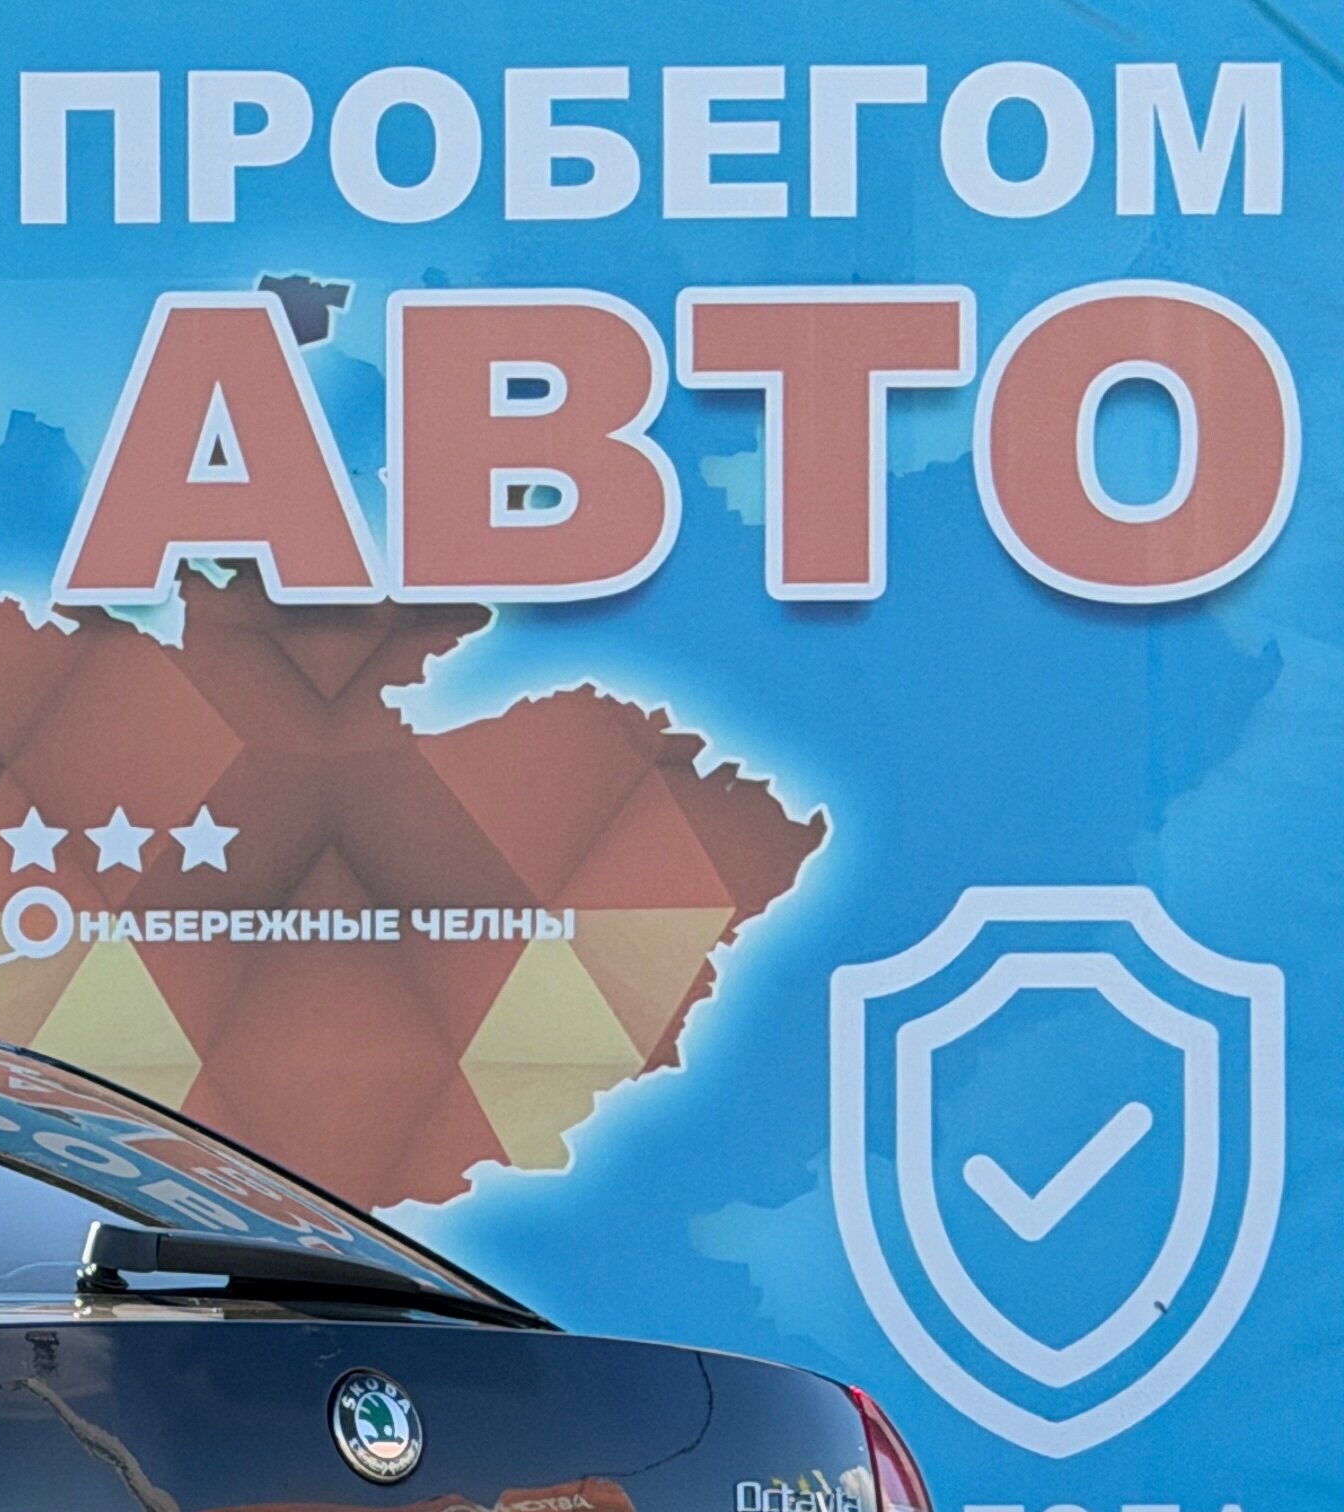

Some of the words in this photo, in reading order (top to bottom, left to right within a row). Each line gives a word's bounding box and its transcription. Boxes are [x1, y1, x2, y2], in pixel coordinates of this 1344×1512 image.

[19, 60, 1285, 225] ПРОБЕГОМ
[52, 280, 1302, 603] АВТО
[78, 908, 401, 944] НАБЕРЕЖНЫЕ
[410, 906, 576, 942] ЧЕЛНЫ
